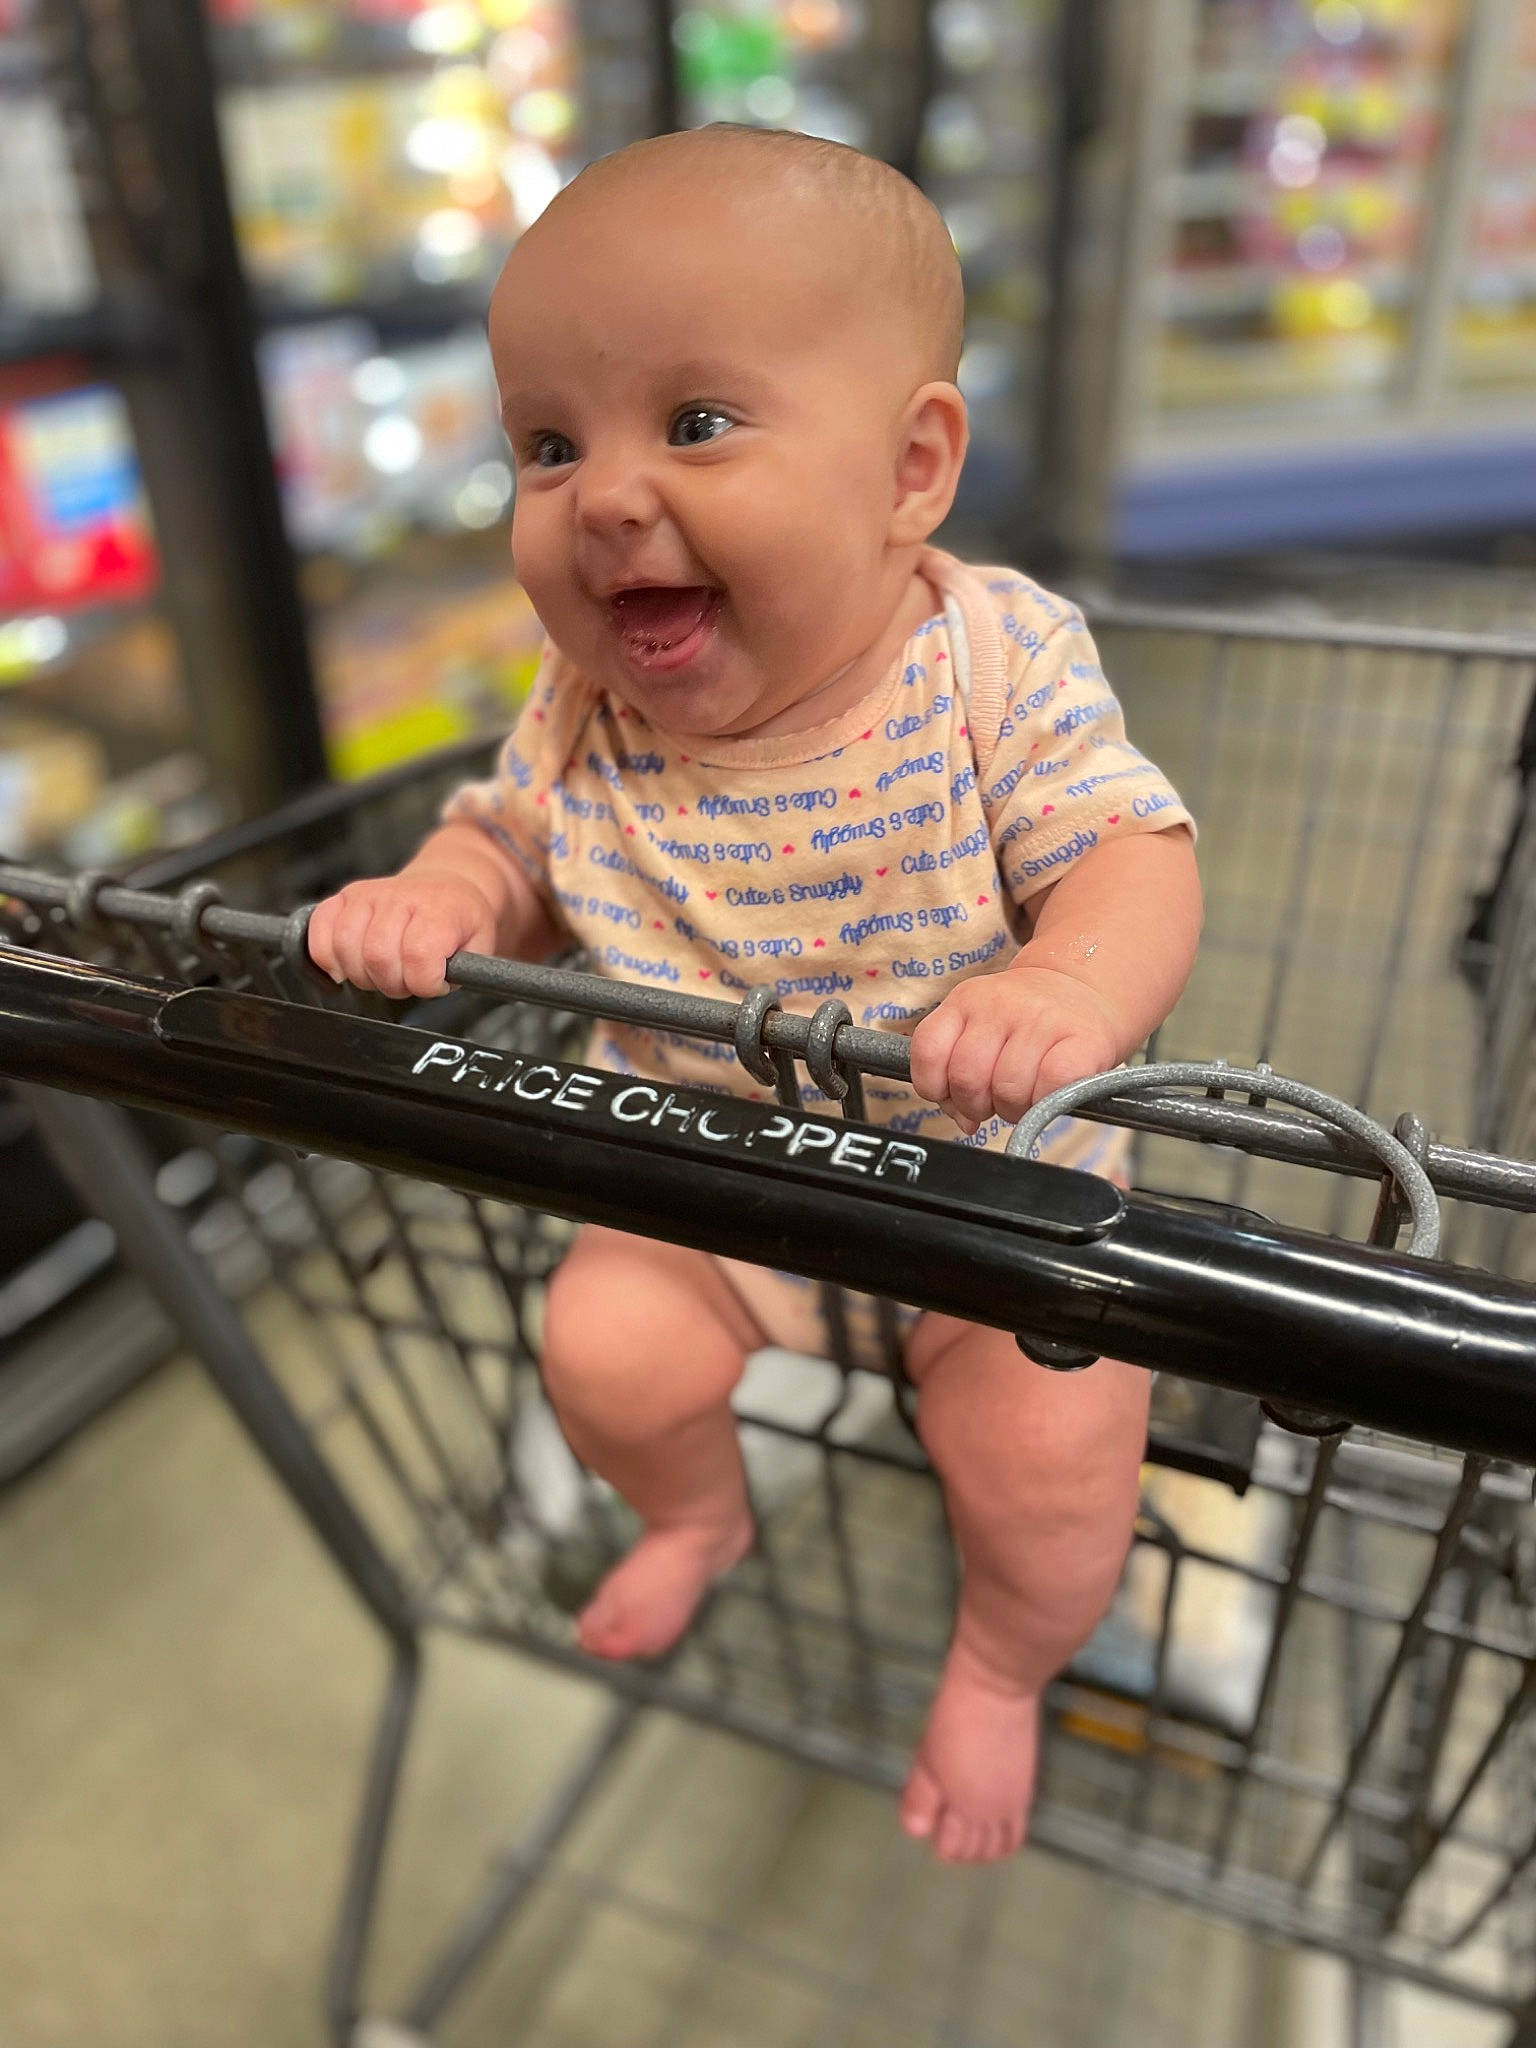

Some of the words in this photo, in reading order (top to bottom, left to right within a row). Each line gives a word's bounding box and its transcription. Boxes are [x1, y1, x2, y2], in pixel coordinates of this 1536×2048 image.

[697, 794, 770, 820] Snuggly
[789, 788, 837, 812] Cute
[904, 802, 945, 827] Cute
[811, 819, 886, 853] Snuggly
[726, 842, 772, 864] Cute
[902, 850, 937, 875] Cute
[1022, 829, 1098, 878] Snuggly
[725, 886, 770, 906] Cute
[788, 872, 863, 901] Snuggly
[839, 911, 914, 946] Snuggly
[932, 902, 968, 929] Cute
[758, 937, 803, 958] Cute
[891, 957, 930, 978] Cute
[775, 970, 853, 996] Snuggly
